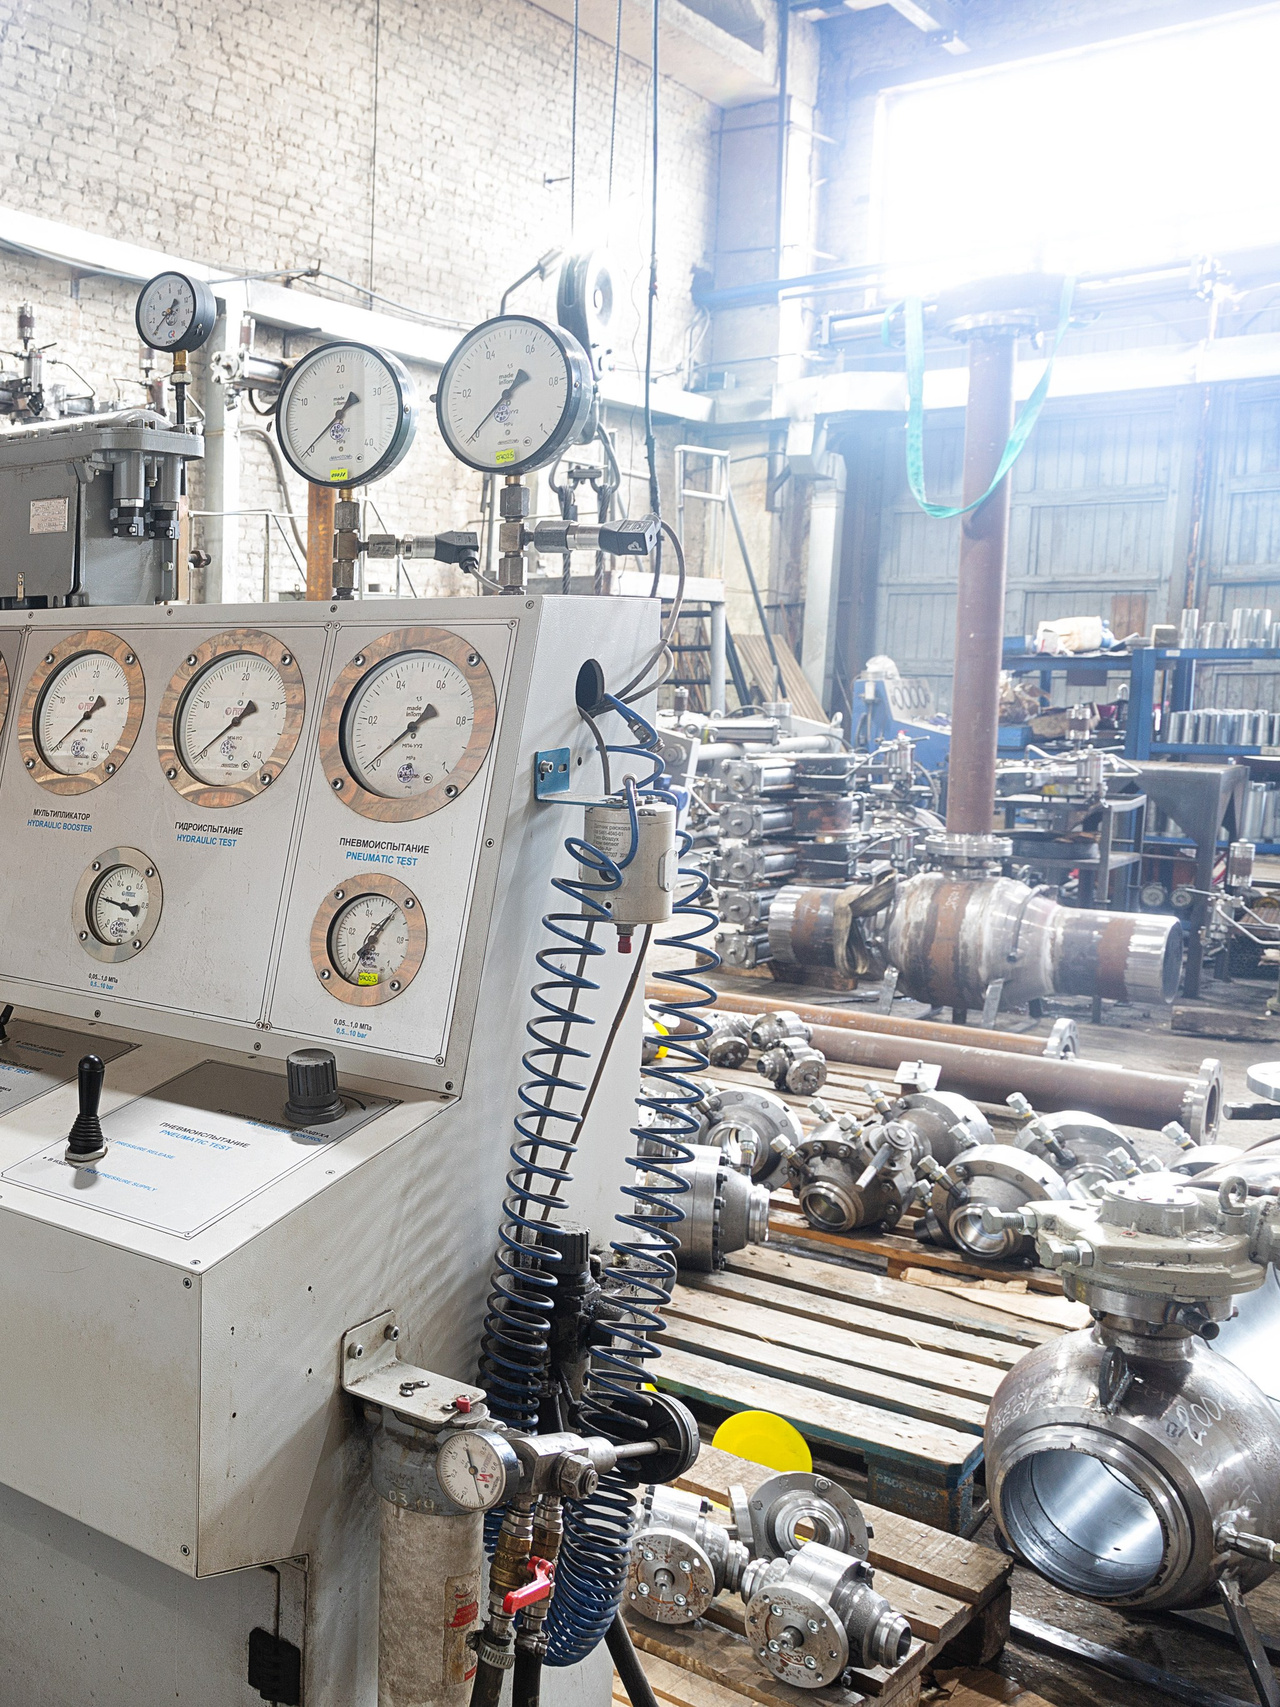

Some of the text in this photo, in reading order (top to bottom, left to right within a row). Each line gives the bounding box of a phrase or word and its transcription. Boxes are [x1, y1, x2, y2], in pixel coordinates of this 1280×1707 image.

[526, 345, 536, 354] 0,6
[486, 350, 496, 360] 0,4
[336, 364, 346, 374] 20
[498, 372, 514, 380] made
[548, 377, 559, 387] 0,8
[372, 387, 382, 396] 30
[462, 388, 472, 398] 0,2
[301, 398, 308, 406] 10
[364, 438, 374, 447] 40
[92, 670, 100, 679] 20
[241, 673, 251, 682] 20
[396, 680, 406, 691] 0,4
[436, 680, 447, 691] 0,6
[60, 696, 66, 705] 10
[117, 697, 125, 706] 30
[203, 700, 210, 709] 10
[271, 702, 279, 711] 30
[368, 716, 378, 726] 0,2
[456, 716, 466, 727] 0,8
[101, 742, 109, 750] 40
[252, 752, 262, 760] 40
[32, 808, 91, 821] МУЛЬТИПЛИКАТОР
[26, 819, 93, 833] HYDRAULIC BOOSTER
[174, 821, 244, 836] ГИДРОИСПЫТАНИЕ
[176, 834, 238, 848] HYDRAULIC TEST
[338, 837, 430, 854] ПНЕВМОИСПЫТАНИЕ
[345, 851, 418, 867] PNEUMATIC TEST
[116, 880, 124, 888] 0,4
[365, 909, 373, 918] 0,4
[348, 927, 357, 936] 0,2
[88, 972, 119, 984] 0,05...1,0 МПа
[90, 980, 106, 989] 0,5...10
[333, 1018, 373, 1031] 0,05...1,0 МПа
[336, 1027, 368, 1039] 0,5...10 bar
[14, 1067, 34, 1076] TEST
[159, 1121, 251, 1149] ПНЕВМОИСПЫТАНИЕ
[257, 1122, 291, 1134] PRESSURE
[291, 1132, 322, 1142] CONTROL
[159, 1129, 233, 1152] PNEUMATIC TEST
[114, 1140, 176, 1160] PRESSURE RELEASE
[99, 1172, 132, 1186] PRESSURE
[132, 1180, 158, 1192] SUPPLY
